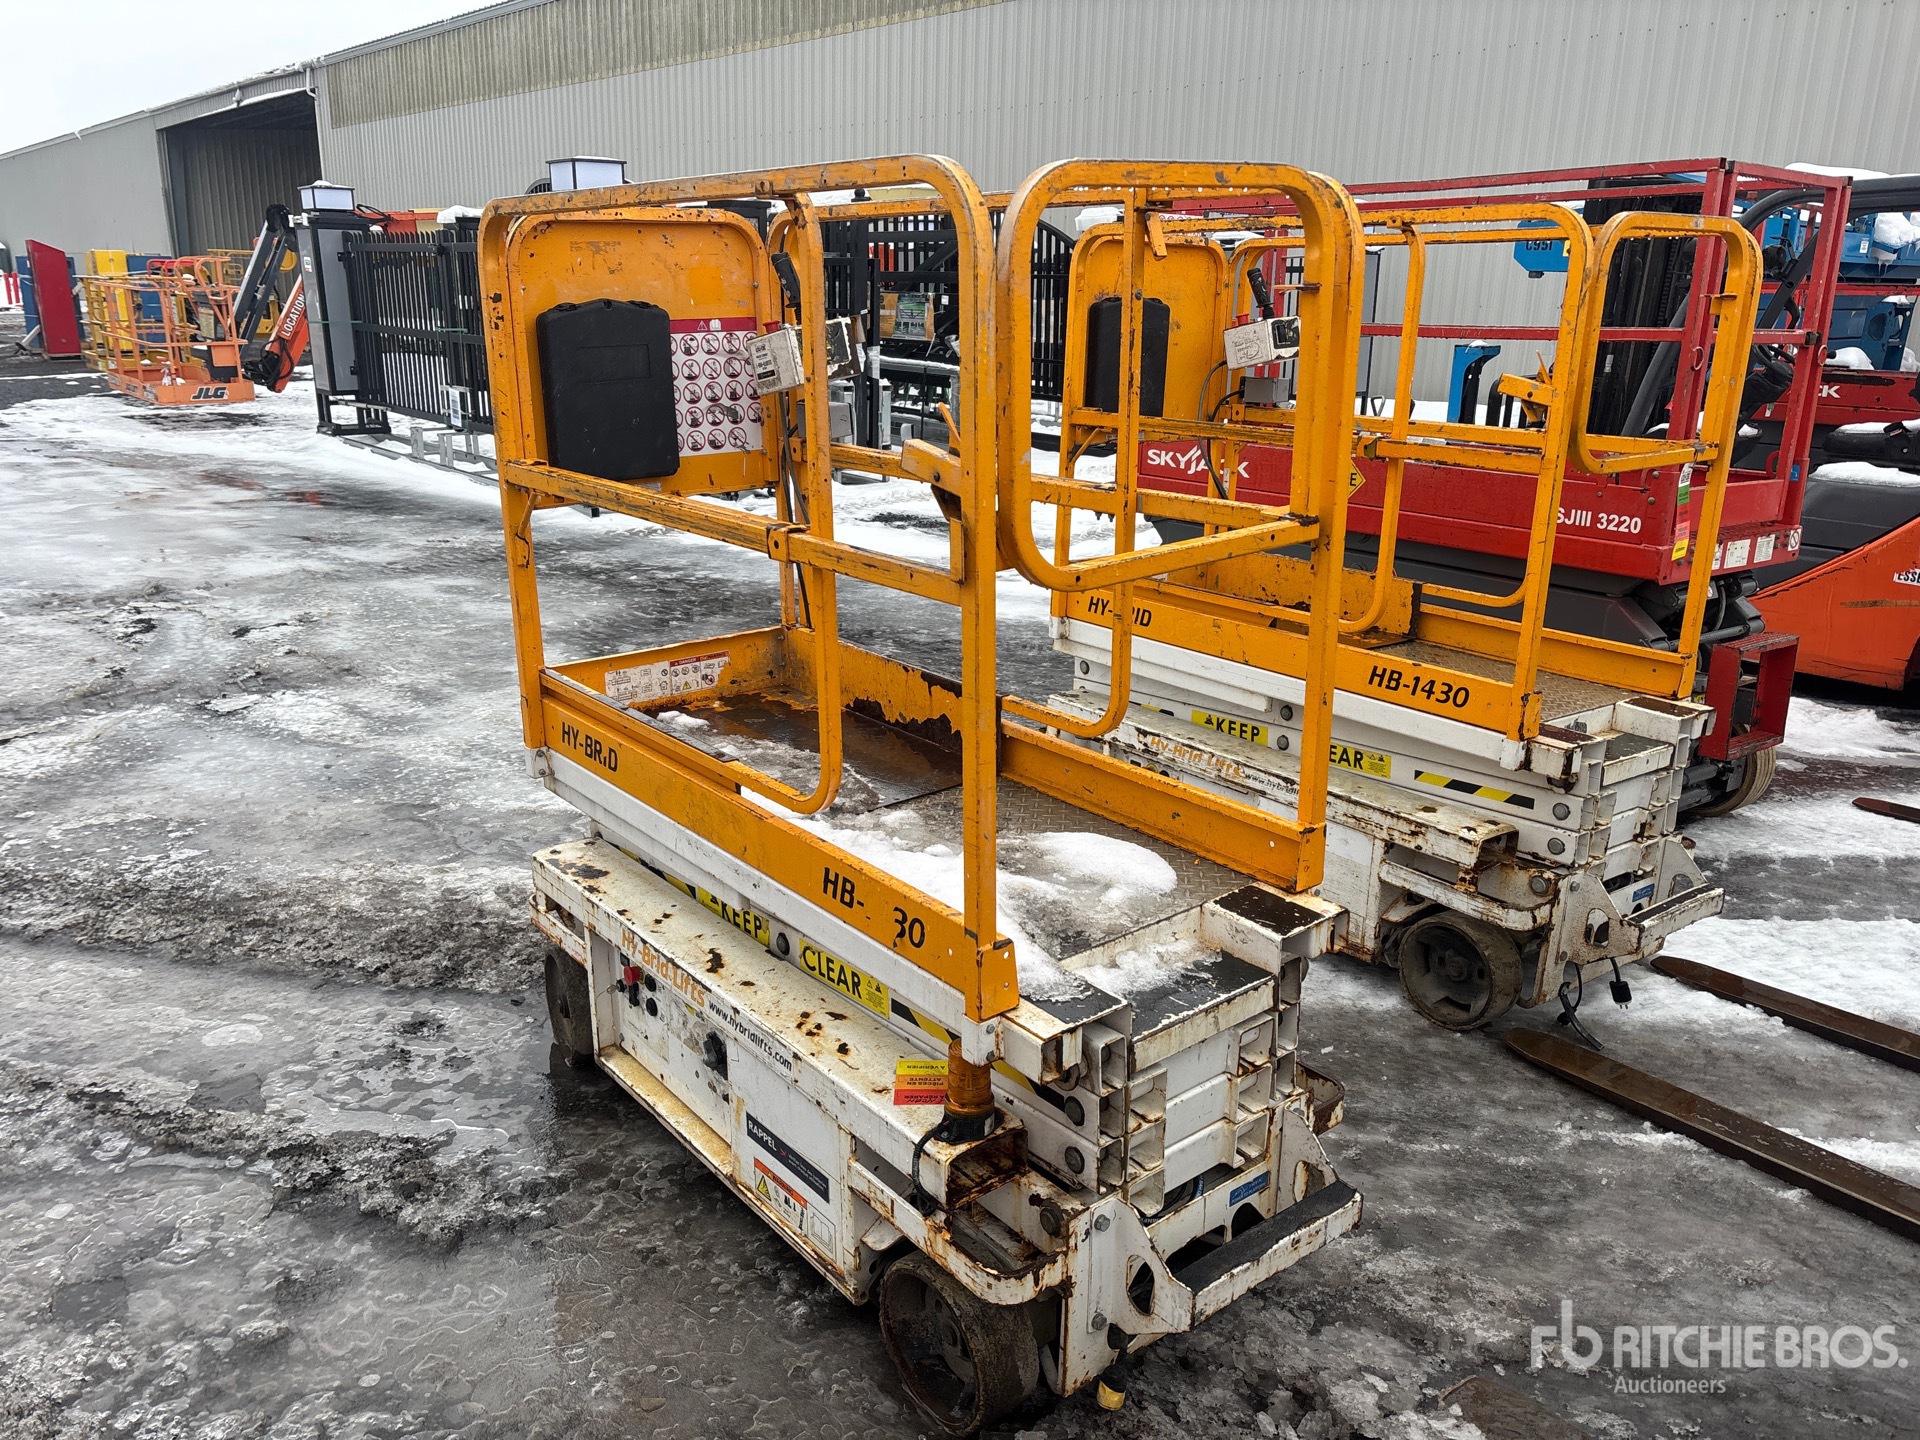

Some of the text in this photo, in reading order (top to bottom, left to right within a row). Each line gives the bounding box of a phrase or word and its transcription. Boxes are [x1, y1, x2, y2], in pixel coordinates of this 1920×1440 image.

[190, 386, 228, 401] JLG
[1596, 512, 1642, 534] 3220
[1088, 595, 1153, 627] HY-ID
[1368, 665, 1470, 708] HB-1430
[1216, 717, 1260, 742] KEEP
[1329, 744, 1363, 770] EAR
[721, 900, 762, 939] KEEP
[673, 965, 705, 1008] Lifts
[802, 945, 862, 1000] CLEAR
[708, 1000, 792, 1072] www.hybridlifts.com
[748, 1119, 778, 1152] RAPPEL
